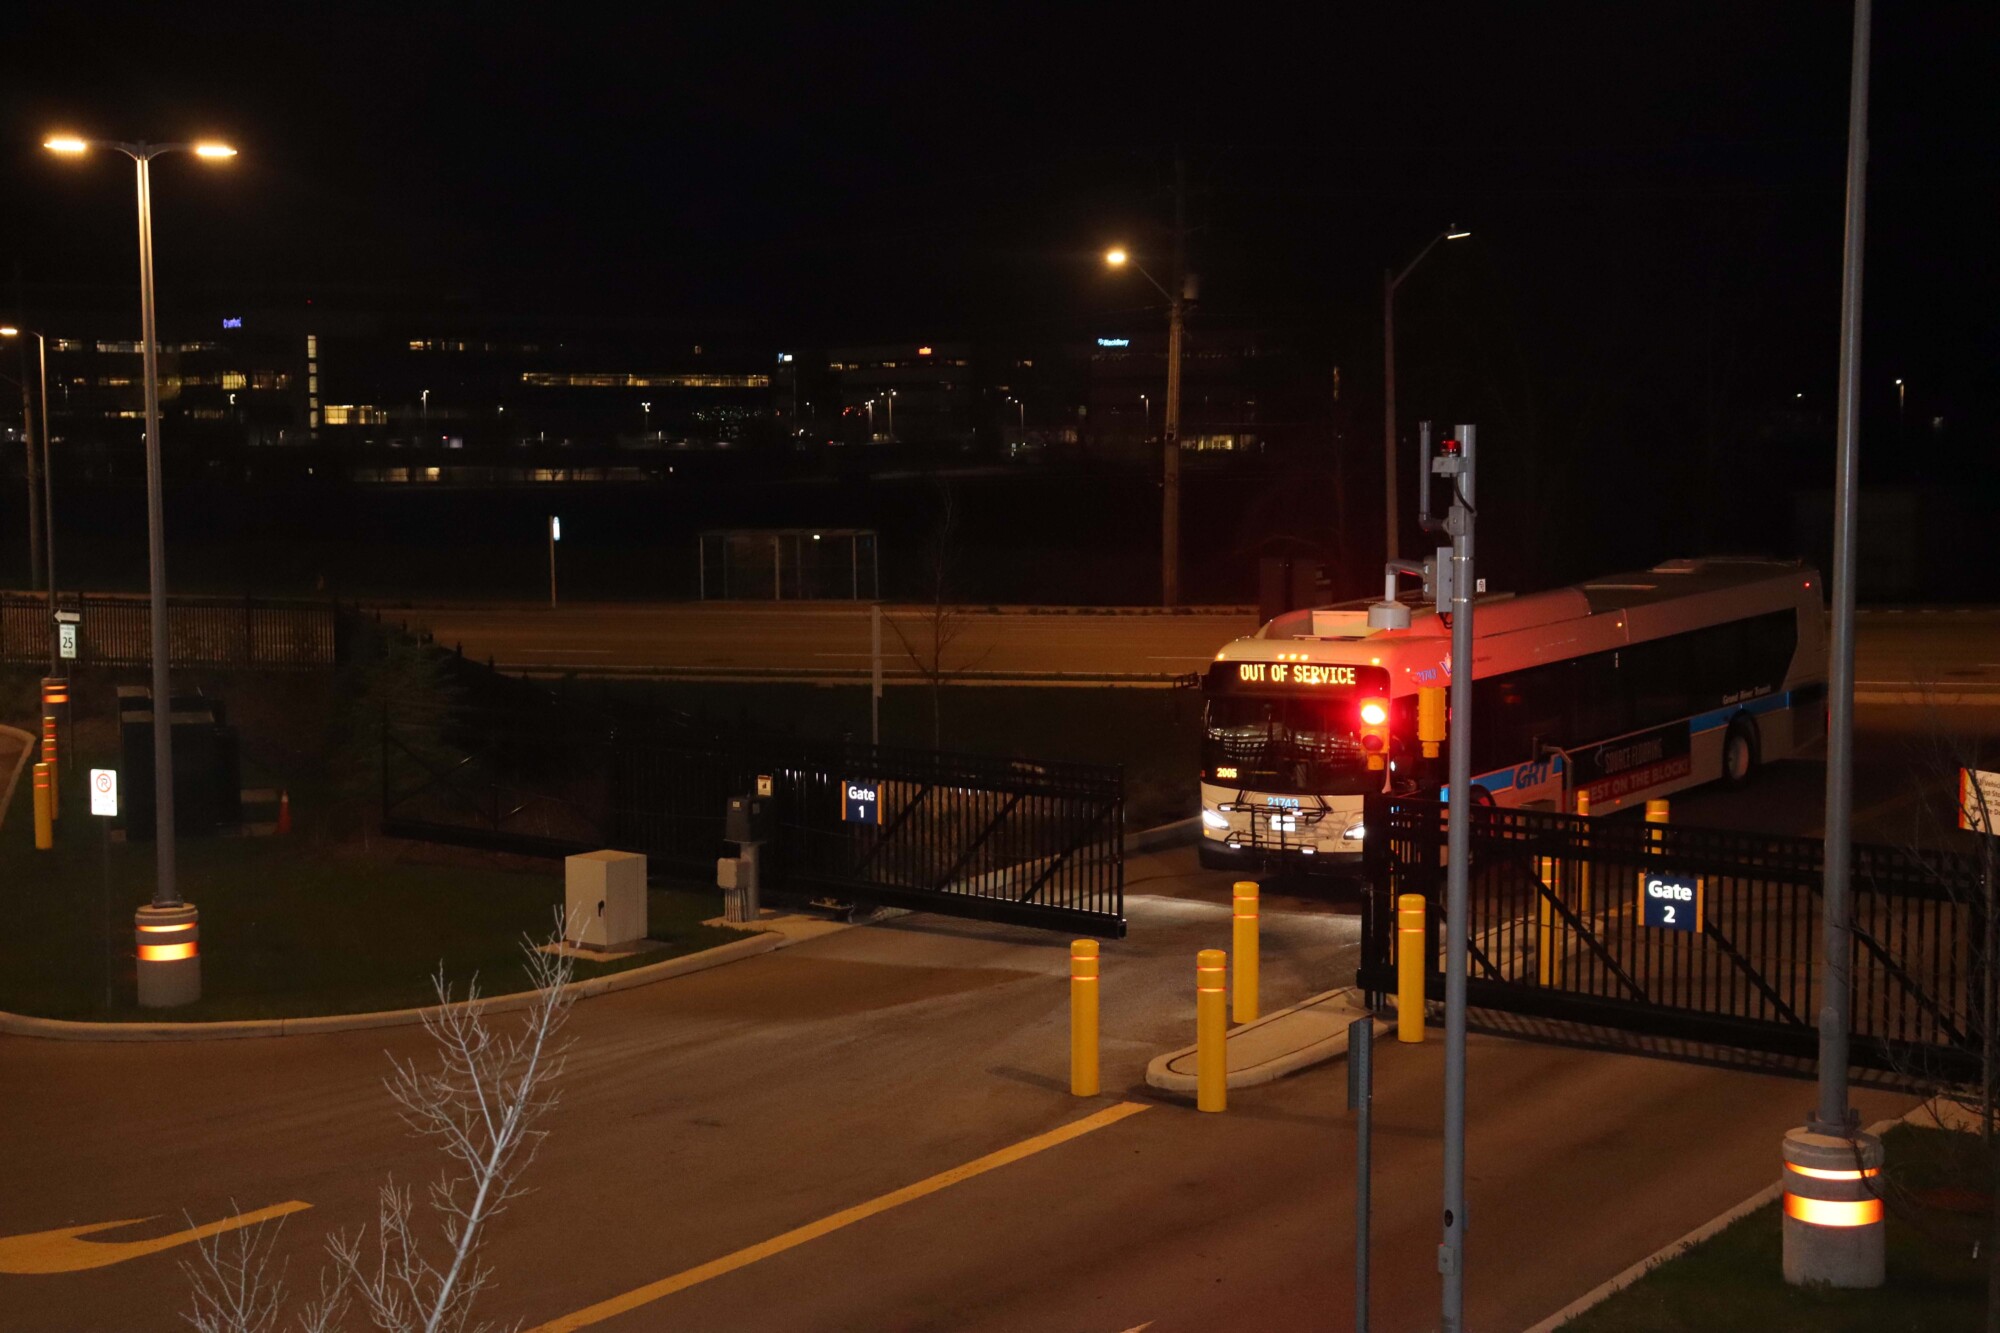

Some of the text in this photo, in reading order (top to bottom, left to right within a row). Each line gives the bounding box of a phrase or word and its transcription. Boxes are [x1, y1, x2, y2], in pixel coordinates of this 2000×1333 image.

[62, 637, 73, 649] 25
[1239, 664, 1357, 685] OUT OF SERVICE
[1216, 767, 1238, 779] 2005
[1515, 761, 1550, 790] GRT
[1611, 775, 1628, 794] ON
[1630, 770, 1650, 789] THE
[848, 786, 875, 801] Gate
[1267, 796, 1299, 809] 21743
[858, 805, 865, 818] 1
[1648, 880, 1692, 902] Gate
[1663, 905, 1676, 923] 2
